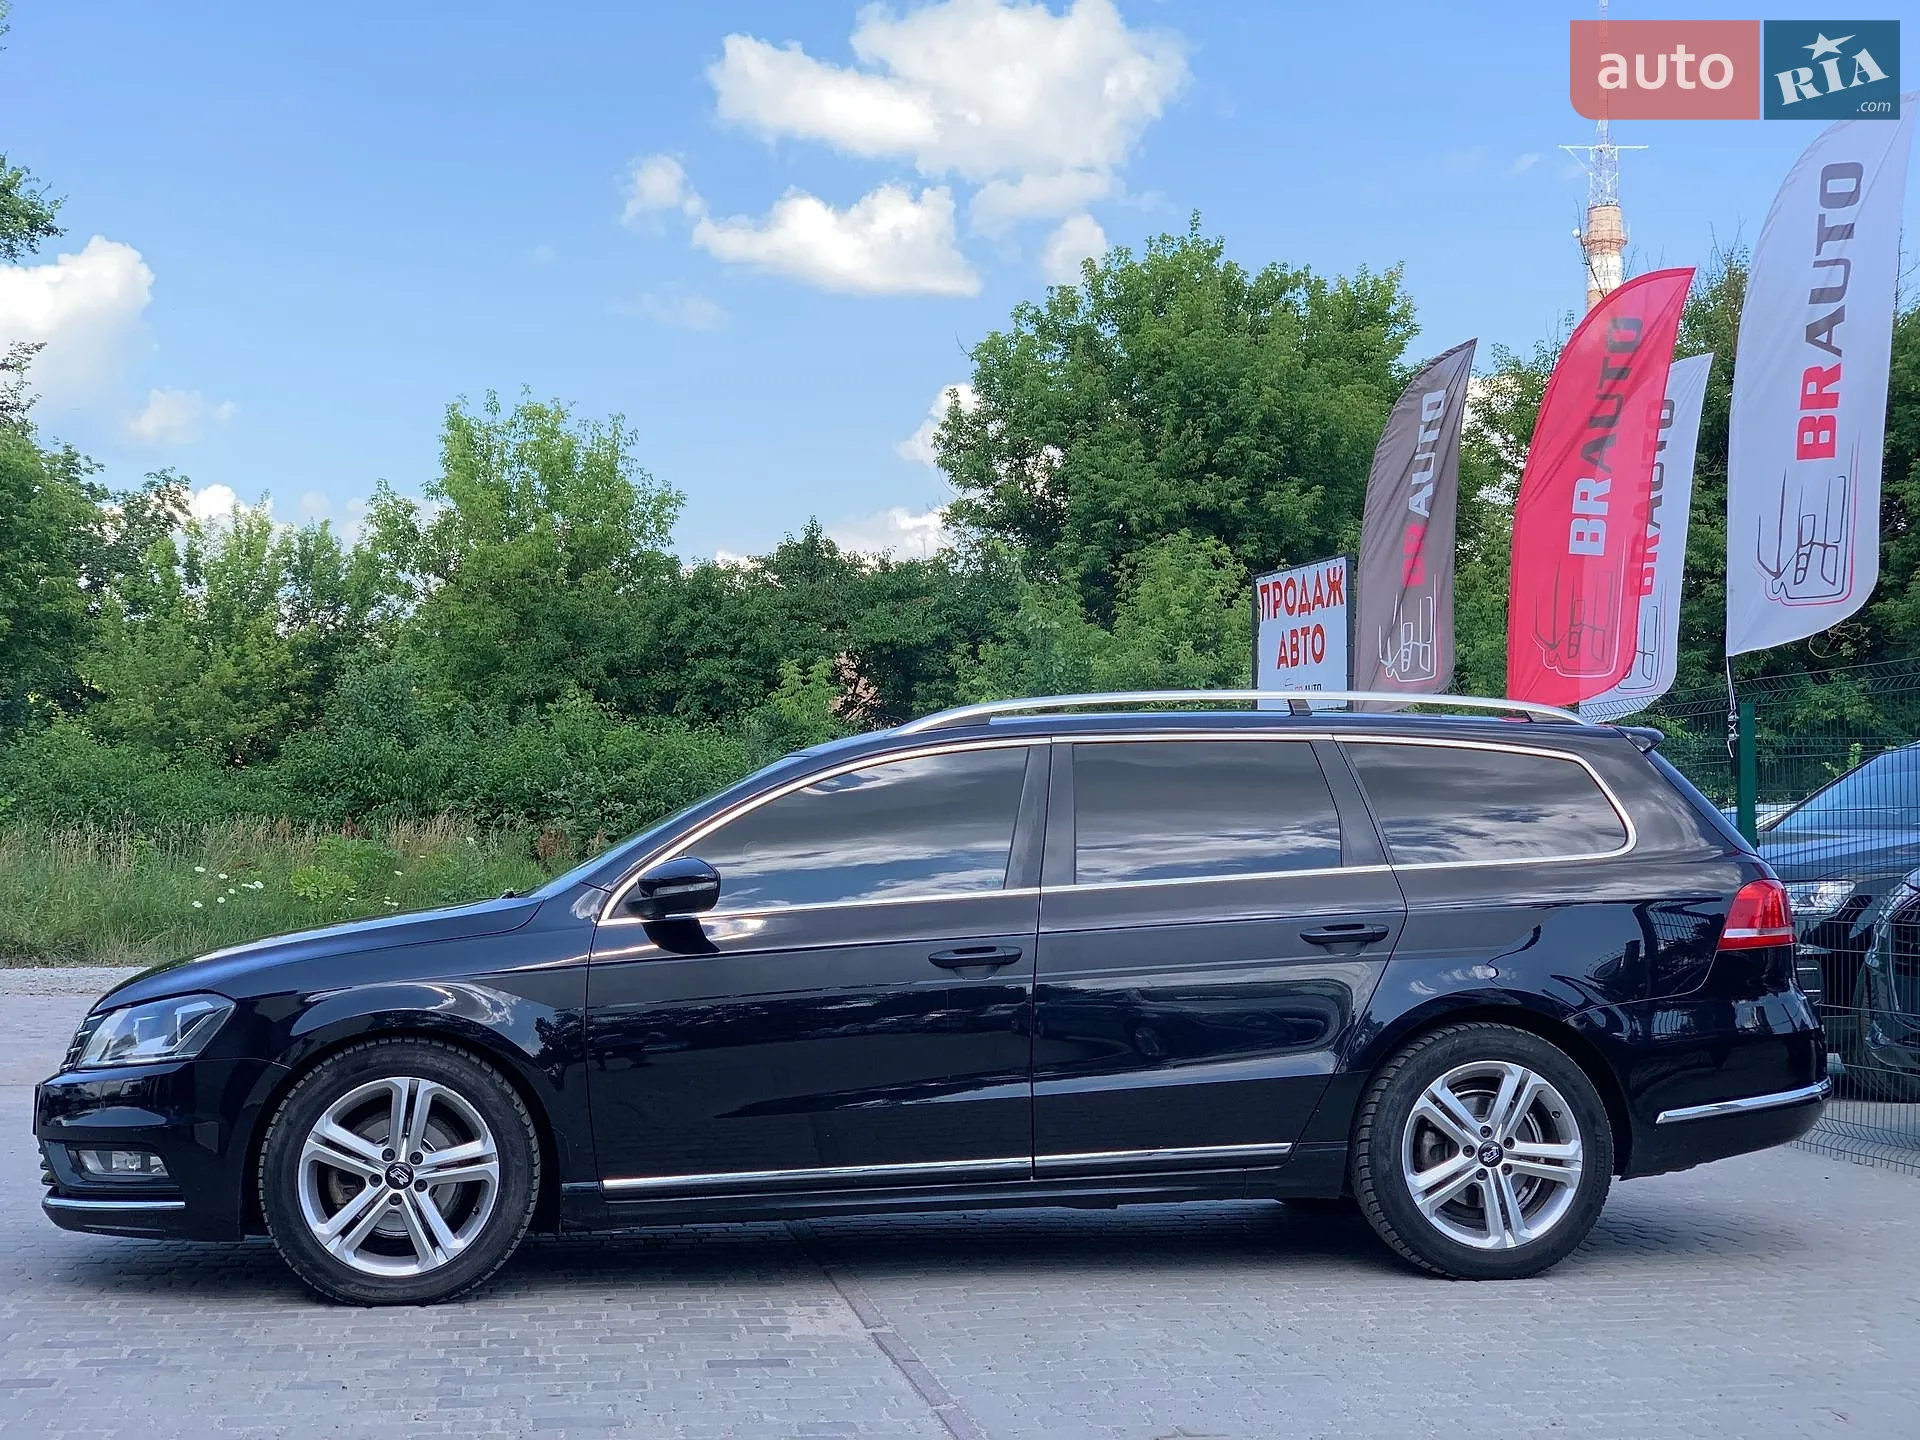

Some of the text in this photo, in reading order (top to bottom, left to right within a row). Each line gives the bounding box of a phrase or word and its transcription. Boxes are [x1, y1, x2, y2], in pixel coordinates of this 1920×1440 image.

[1796, 161, 1863, 461] BRAUTO
[1568, 315, 1644, 557] BRAUTO
[1259, 565, 1344, 621] ПРОДАЖ
[1277, 623, 1325, 669] АВТО
